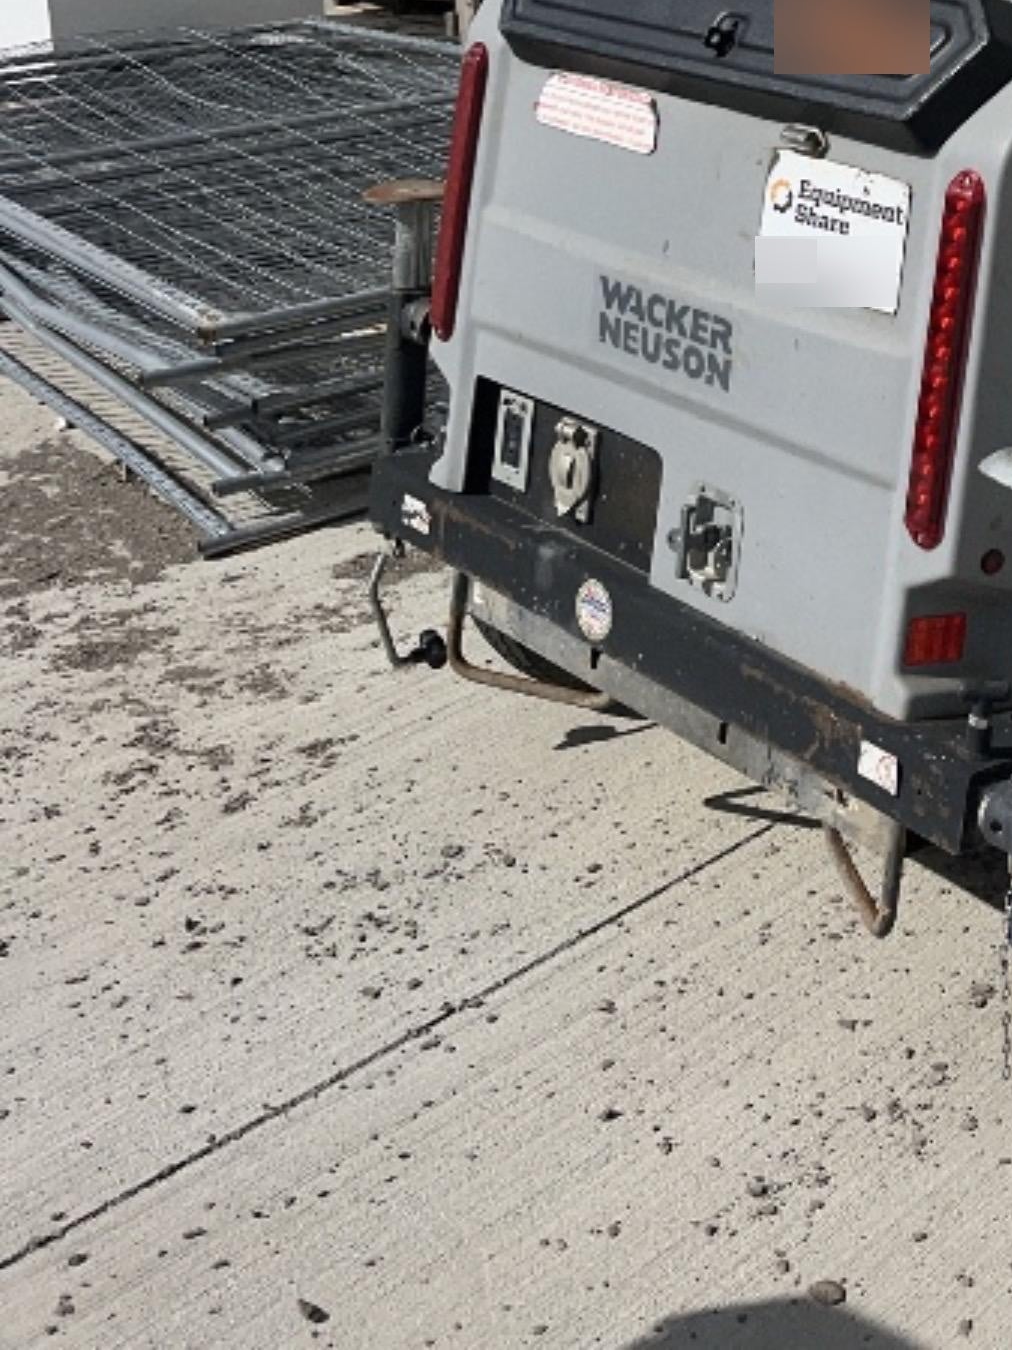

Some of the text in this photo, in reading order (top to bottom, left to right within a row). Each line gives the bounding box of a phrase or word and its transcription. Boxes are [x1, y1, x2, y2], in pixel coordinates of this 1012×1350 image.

[795, 204, 850, 235] Share
[798, 179, 904, 226] Equipment
[600, 275, 732, 355] WACKER
[600, 311, 732, 393] NEUSON
